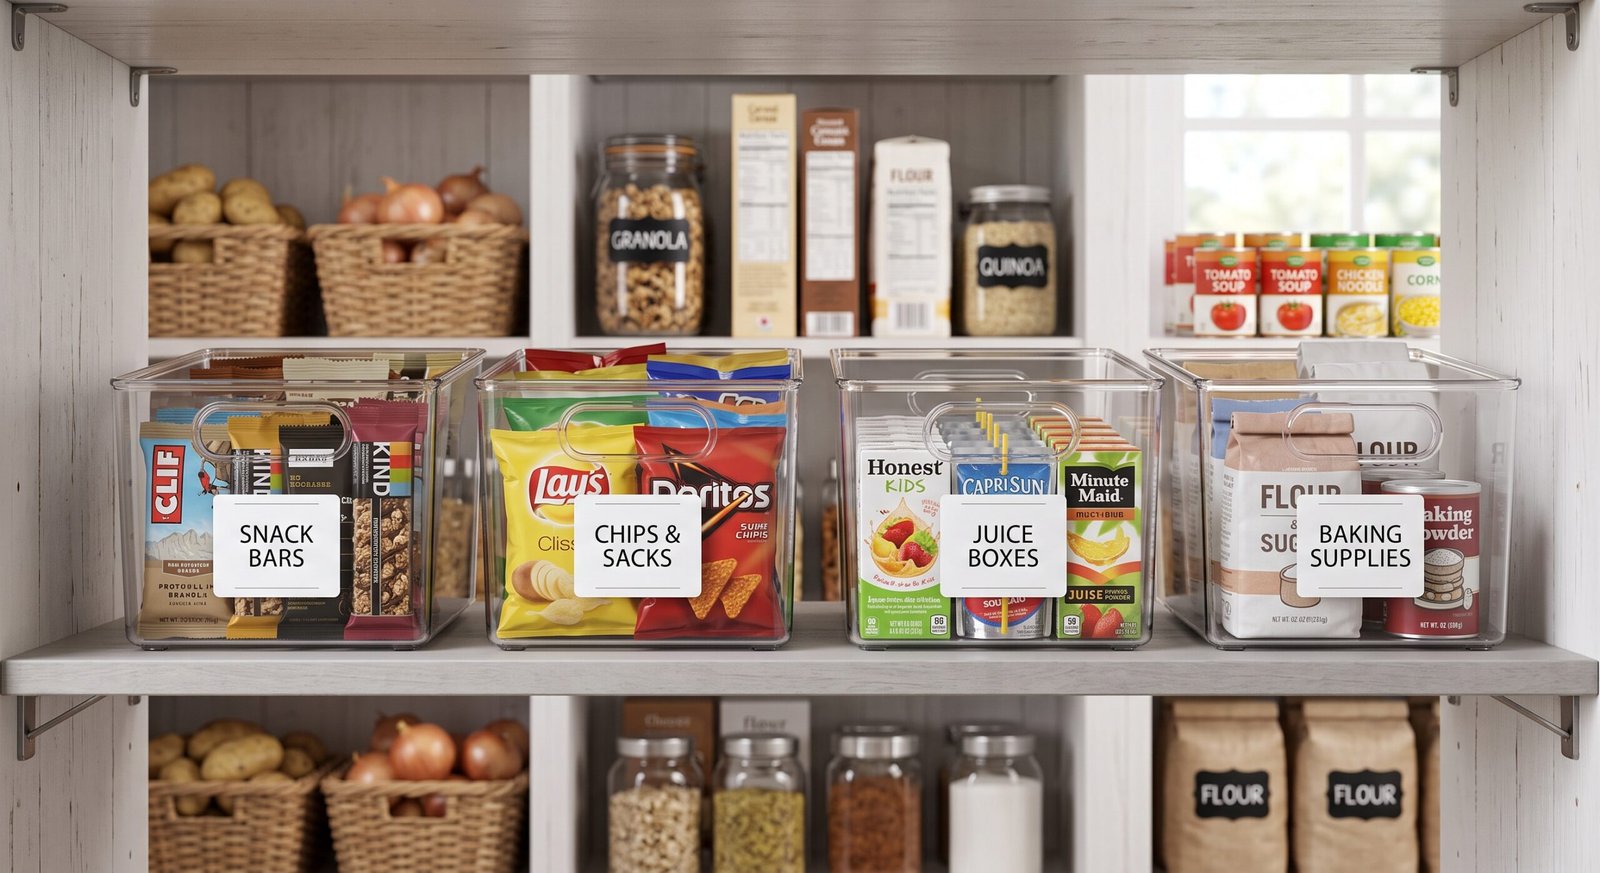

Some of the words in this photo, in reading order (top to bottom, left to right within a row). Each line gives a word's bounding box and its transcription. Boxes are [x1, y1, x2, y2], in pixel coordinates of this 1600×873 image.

[890, 168, 934, 182] FLOUR
[611, 230, 688, 250] GRANOLA
[980, 256, 1046, 277] QUINOA
[1204, 268, 1252, 281] TOMATO
[1270, 268, 1318, 281] TOMATO
[1336, 268, 1385, 280] CHICKEN
[1212, 281, 1246, 293] SOUP
[1278, 281, 1312, 293] SOUP
[1337, 280, 1384, 293] NOODLE
[1357, 441, 1418, 466] LOUR
[373, 441, 390, 497] KIND
[867, 459, 943, 476] Honest
[155, 451, 180, 515] CLIF
[534, 468, 605, 506] Lay's
[885, 479, 926, 493] KIDS
[1070, 472, 1129, 487] Minute
[1078, 488, 1121, 503] Maid
[1290, 519, 1298, 530] &
[1424, 505, 1473, 526] aking
[240, 524, 314, 544] SNACK
[595, 524, 659, 544] CHIPS
[665, 524, 681, 544] &
[972, 524, 1033, 544] JUICE
[1320, 524, 1402, 544] BAKING
[1424, 524, 1474, 541] owder
[249, 548, 304, 568] BARS
[603, 548, 672, 568] SACKS
[969, 548, 1039, 568] BOXES
[1310, 548, 1411, 568] SUPPLIES
[1068, 590, 1103, 600] JUISE
[1067, 617, 1077, 625] 59
[1201, 784, 1265, 806] FLOUR
[1334, 784, 1397, 806] FLOUR
